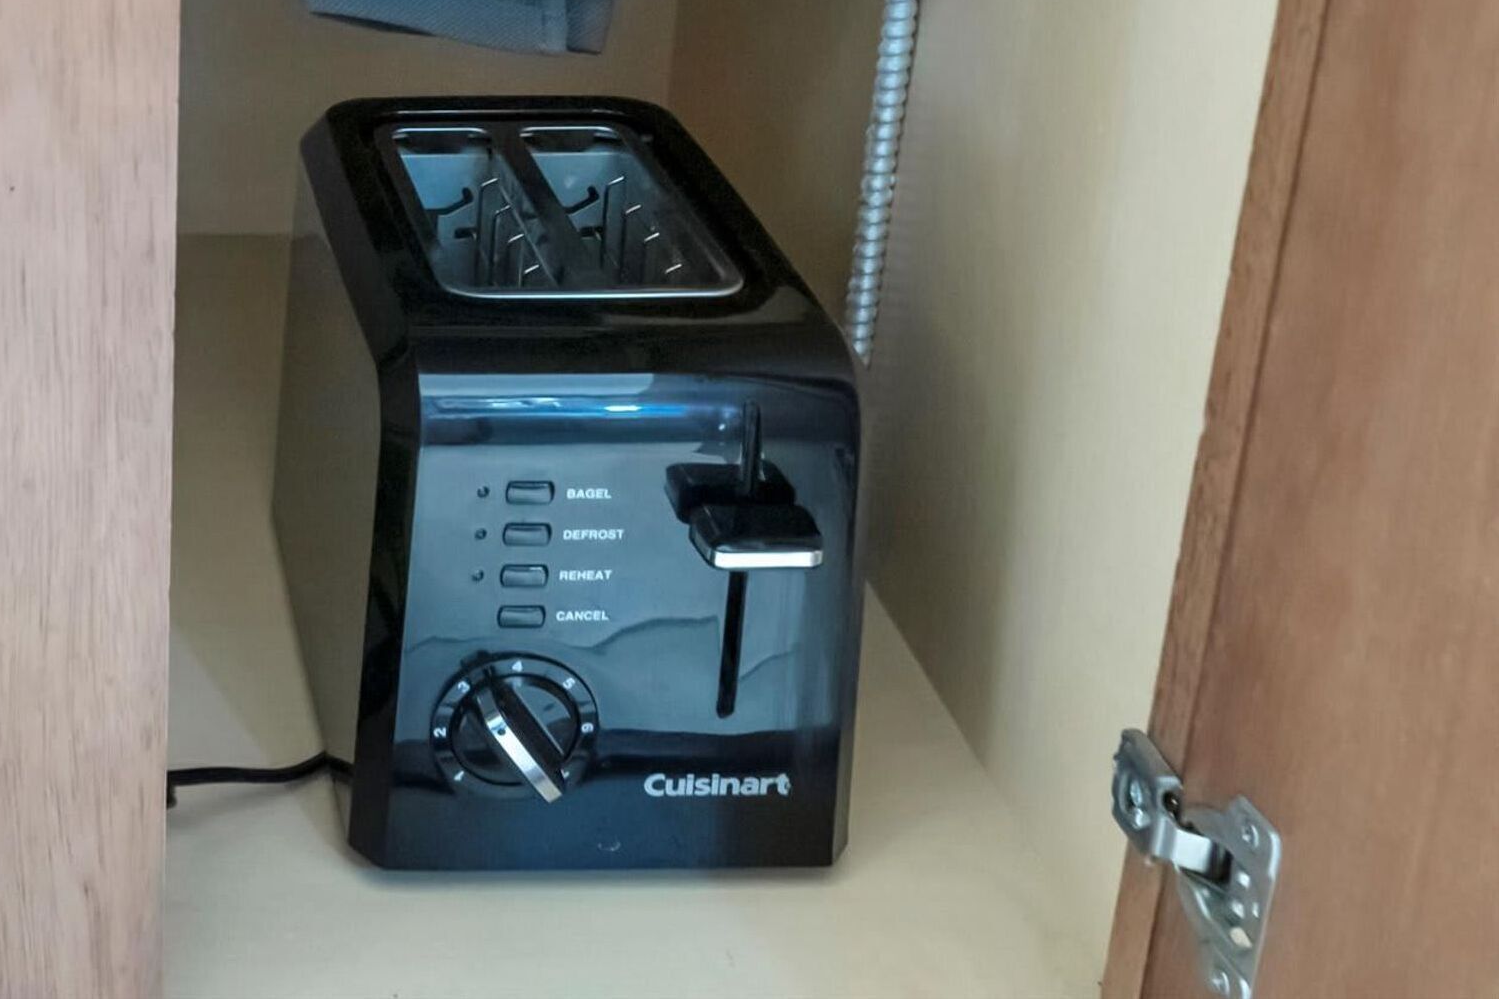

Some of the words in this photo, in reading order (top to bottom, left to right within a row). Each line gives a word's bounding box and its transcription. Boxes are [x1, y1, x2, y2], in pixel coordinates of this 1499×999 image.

[566, 488, 612, 500] BAGEL
[562, 529, 624, 541] DEFROST
[559, 570, 612, 581] REHEAT
[556, 611, 609, 622] CANCEL
[433, 727, 447, 739] 2
[457, 681, 471, 694] 3
[511, 660, 523, 673] 4
[562, 677, 576, 690] 5
[581, 722, 594, 734] 6
[643, 772, 791, 797] Cuisinart
